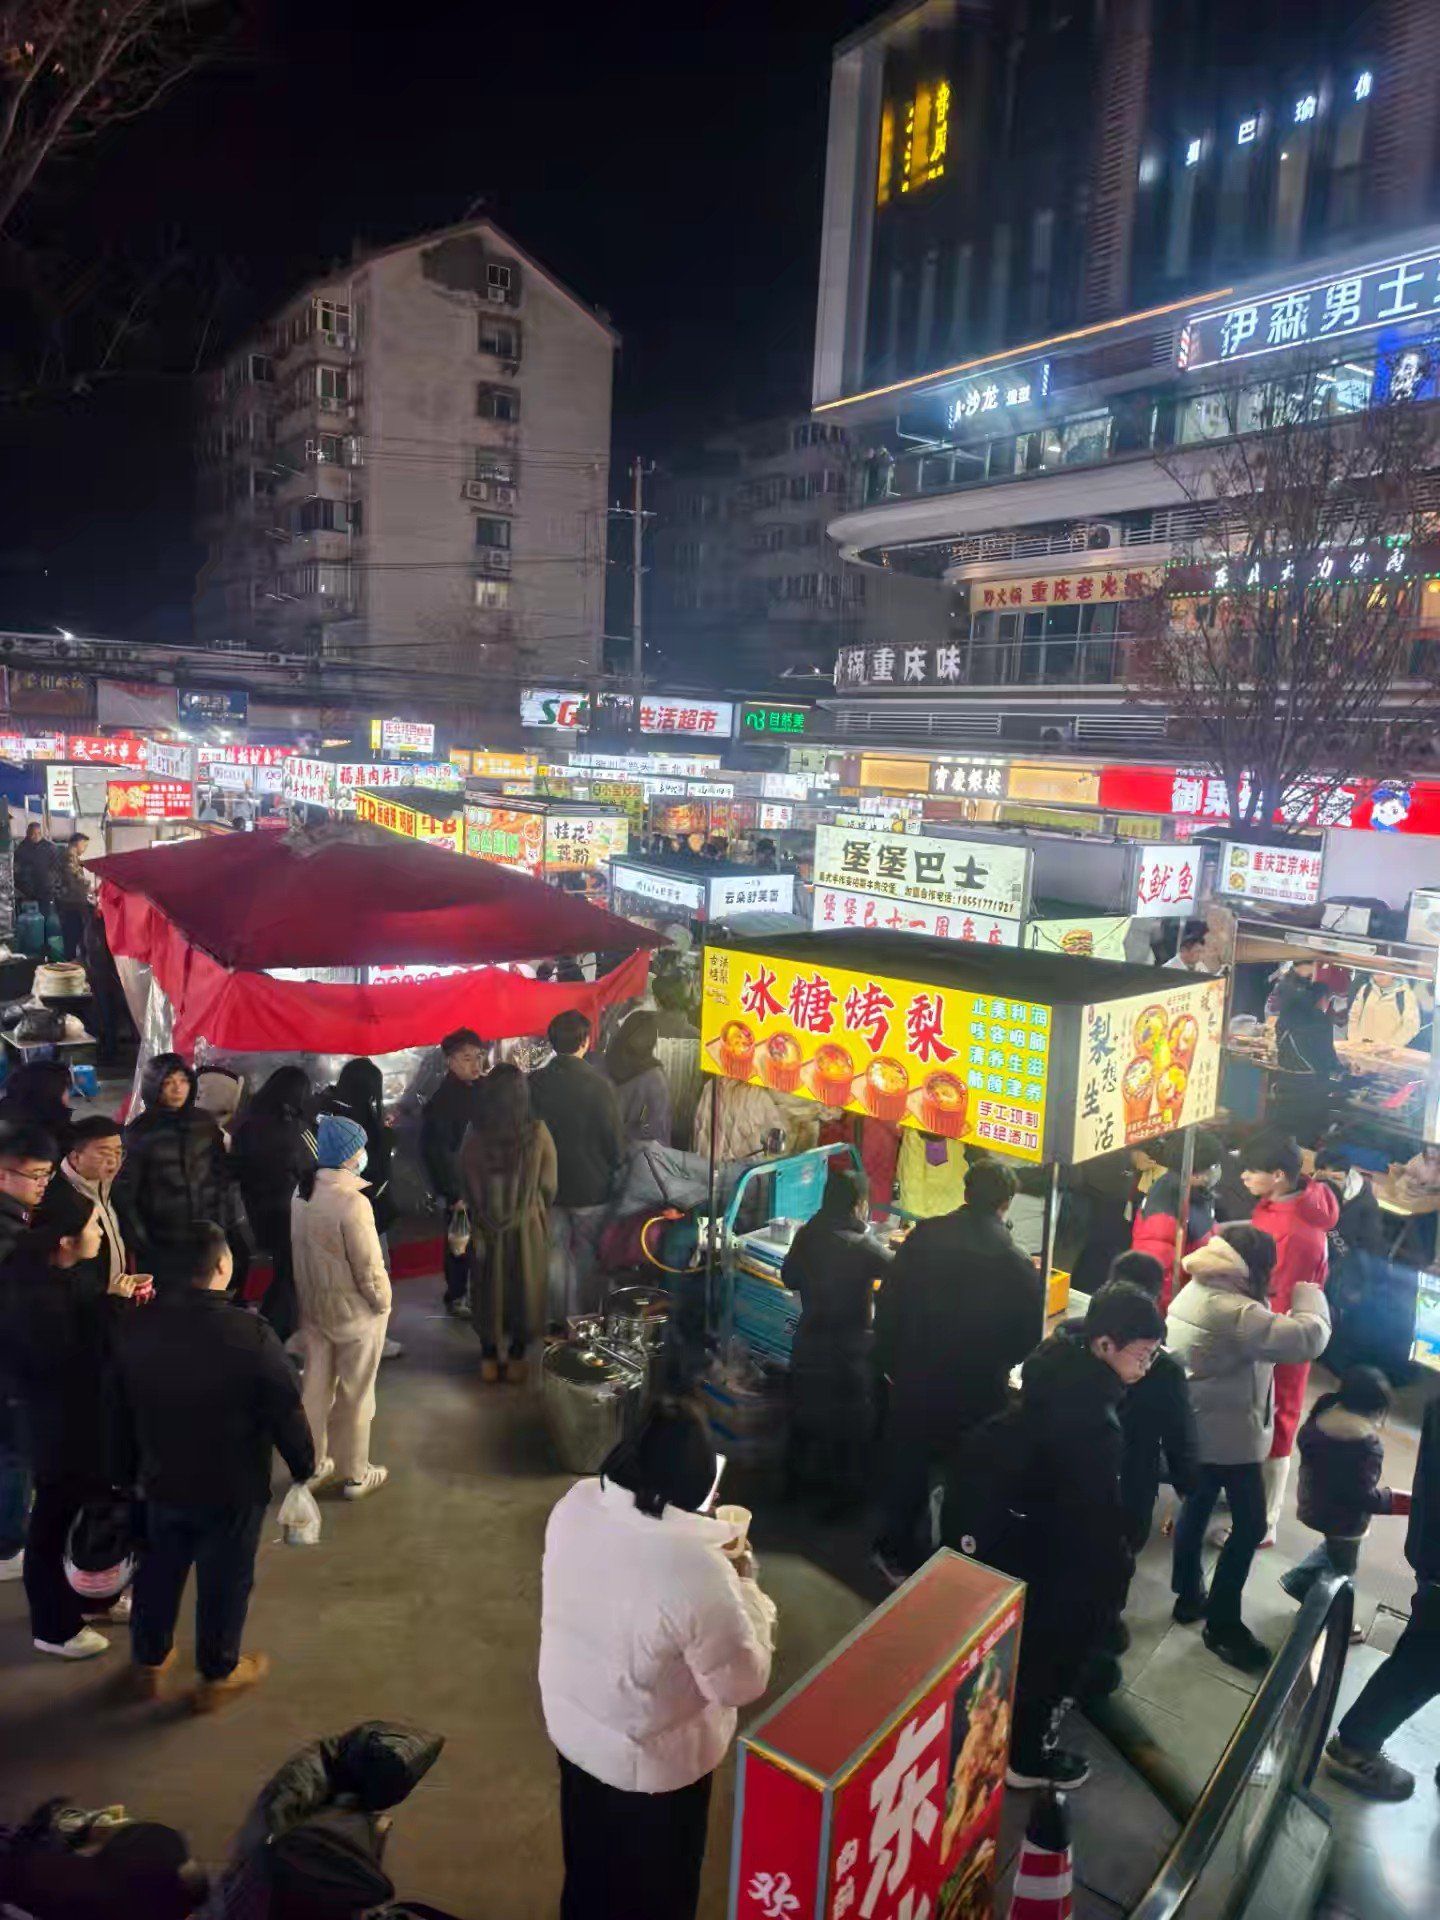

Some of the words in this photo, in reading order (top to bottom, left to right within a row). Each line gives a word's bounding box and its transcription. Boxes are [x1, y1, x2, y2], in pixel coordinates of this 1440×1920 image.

[1220, 257, 1440, 358] 伊森男士
[640, 705, 719, 732] 生活超市
[340, 765, 393, 786] 福鼎肉片
[555, 821, 587, 845] 桂花
[840, 838, 989, 890] 堡堡巴士
[740, 964, 960, 1065] 冰糖烤梨
[979, 1121, 1038, 1149] 拒绝添加
